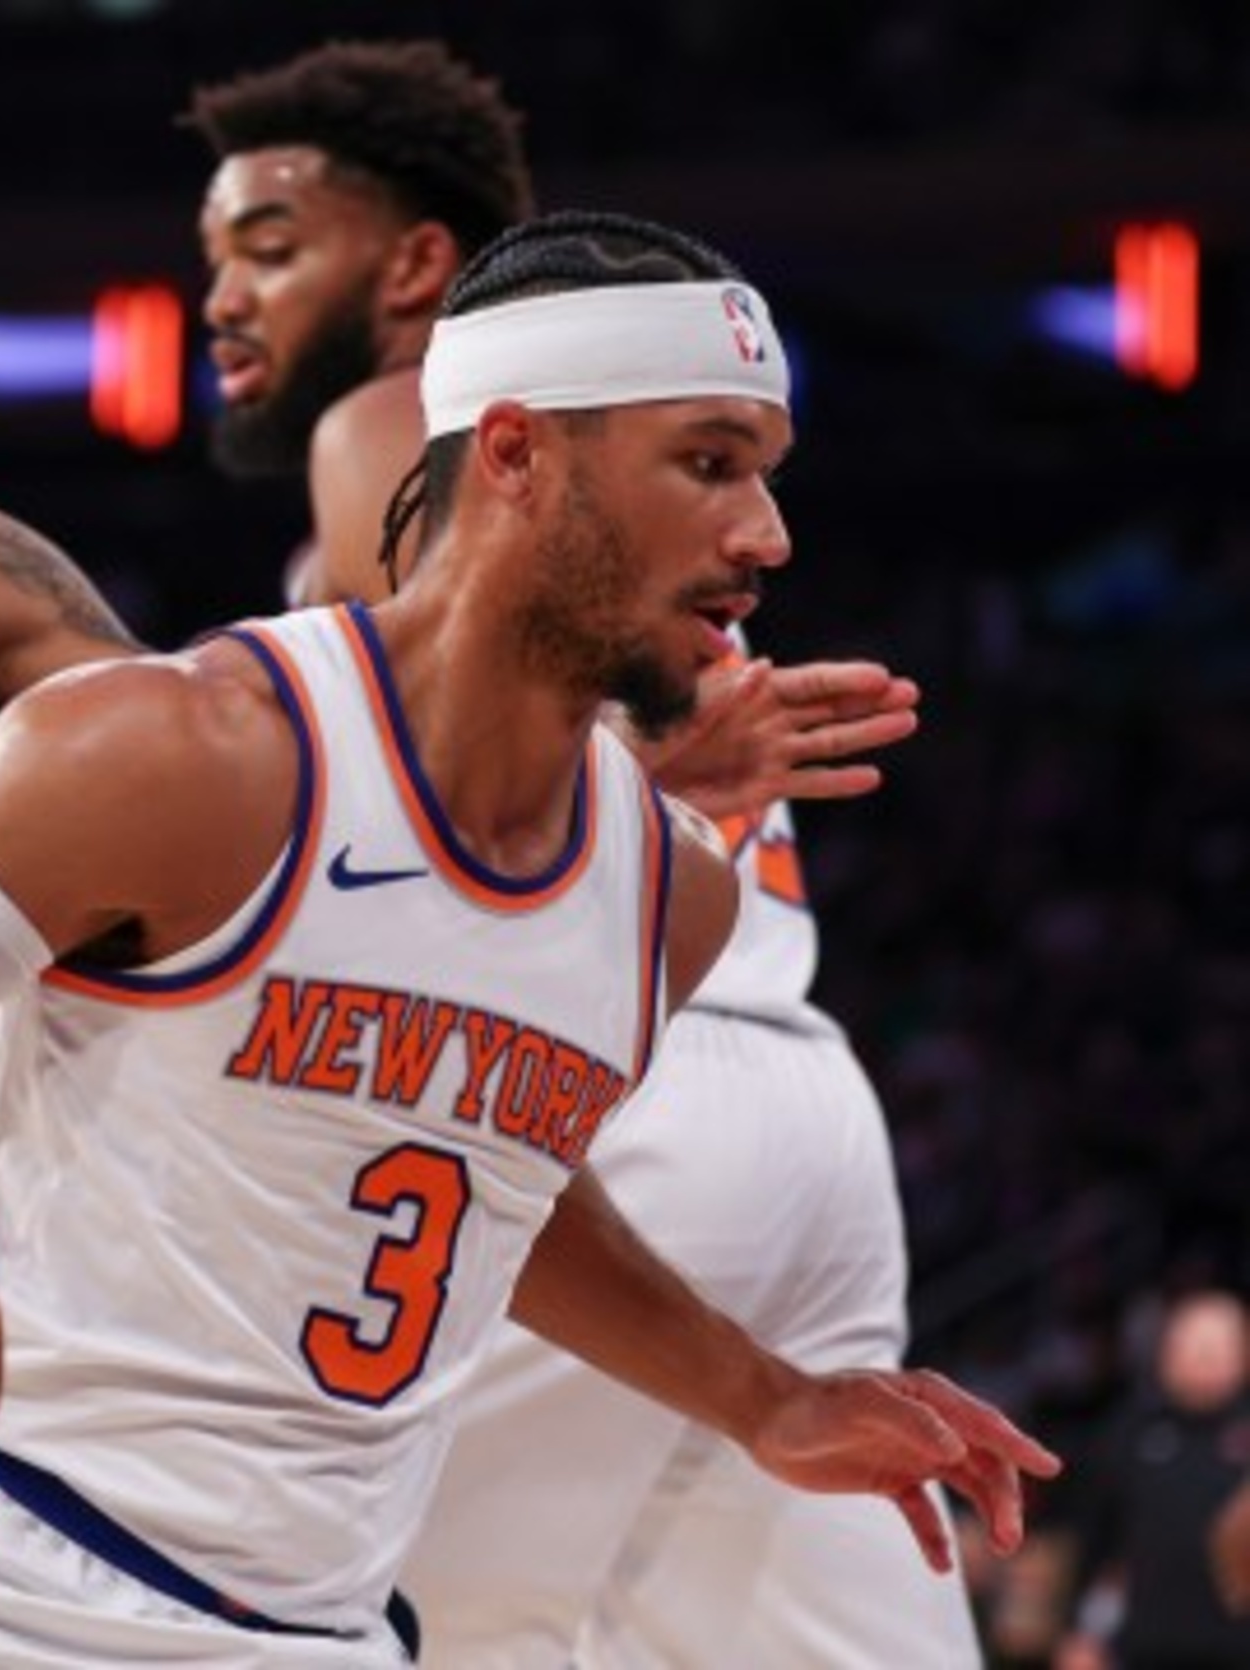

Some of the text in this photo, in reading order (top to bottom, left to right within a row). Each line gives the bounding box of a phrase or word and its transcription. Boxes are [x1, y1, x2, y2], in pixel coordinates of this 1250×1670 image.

[225, 975, 627, 1170] NEW YORK
[298, 1140, 472, 1409] 3
